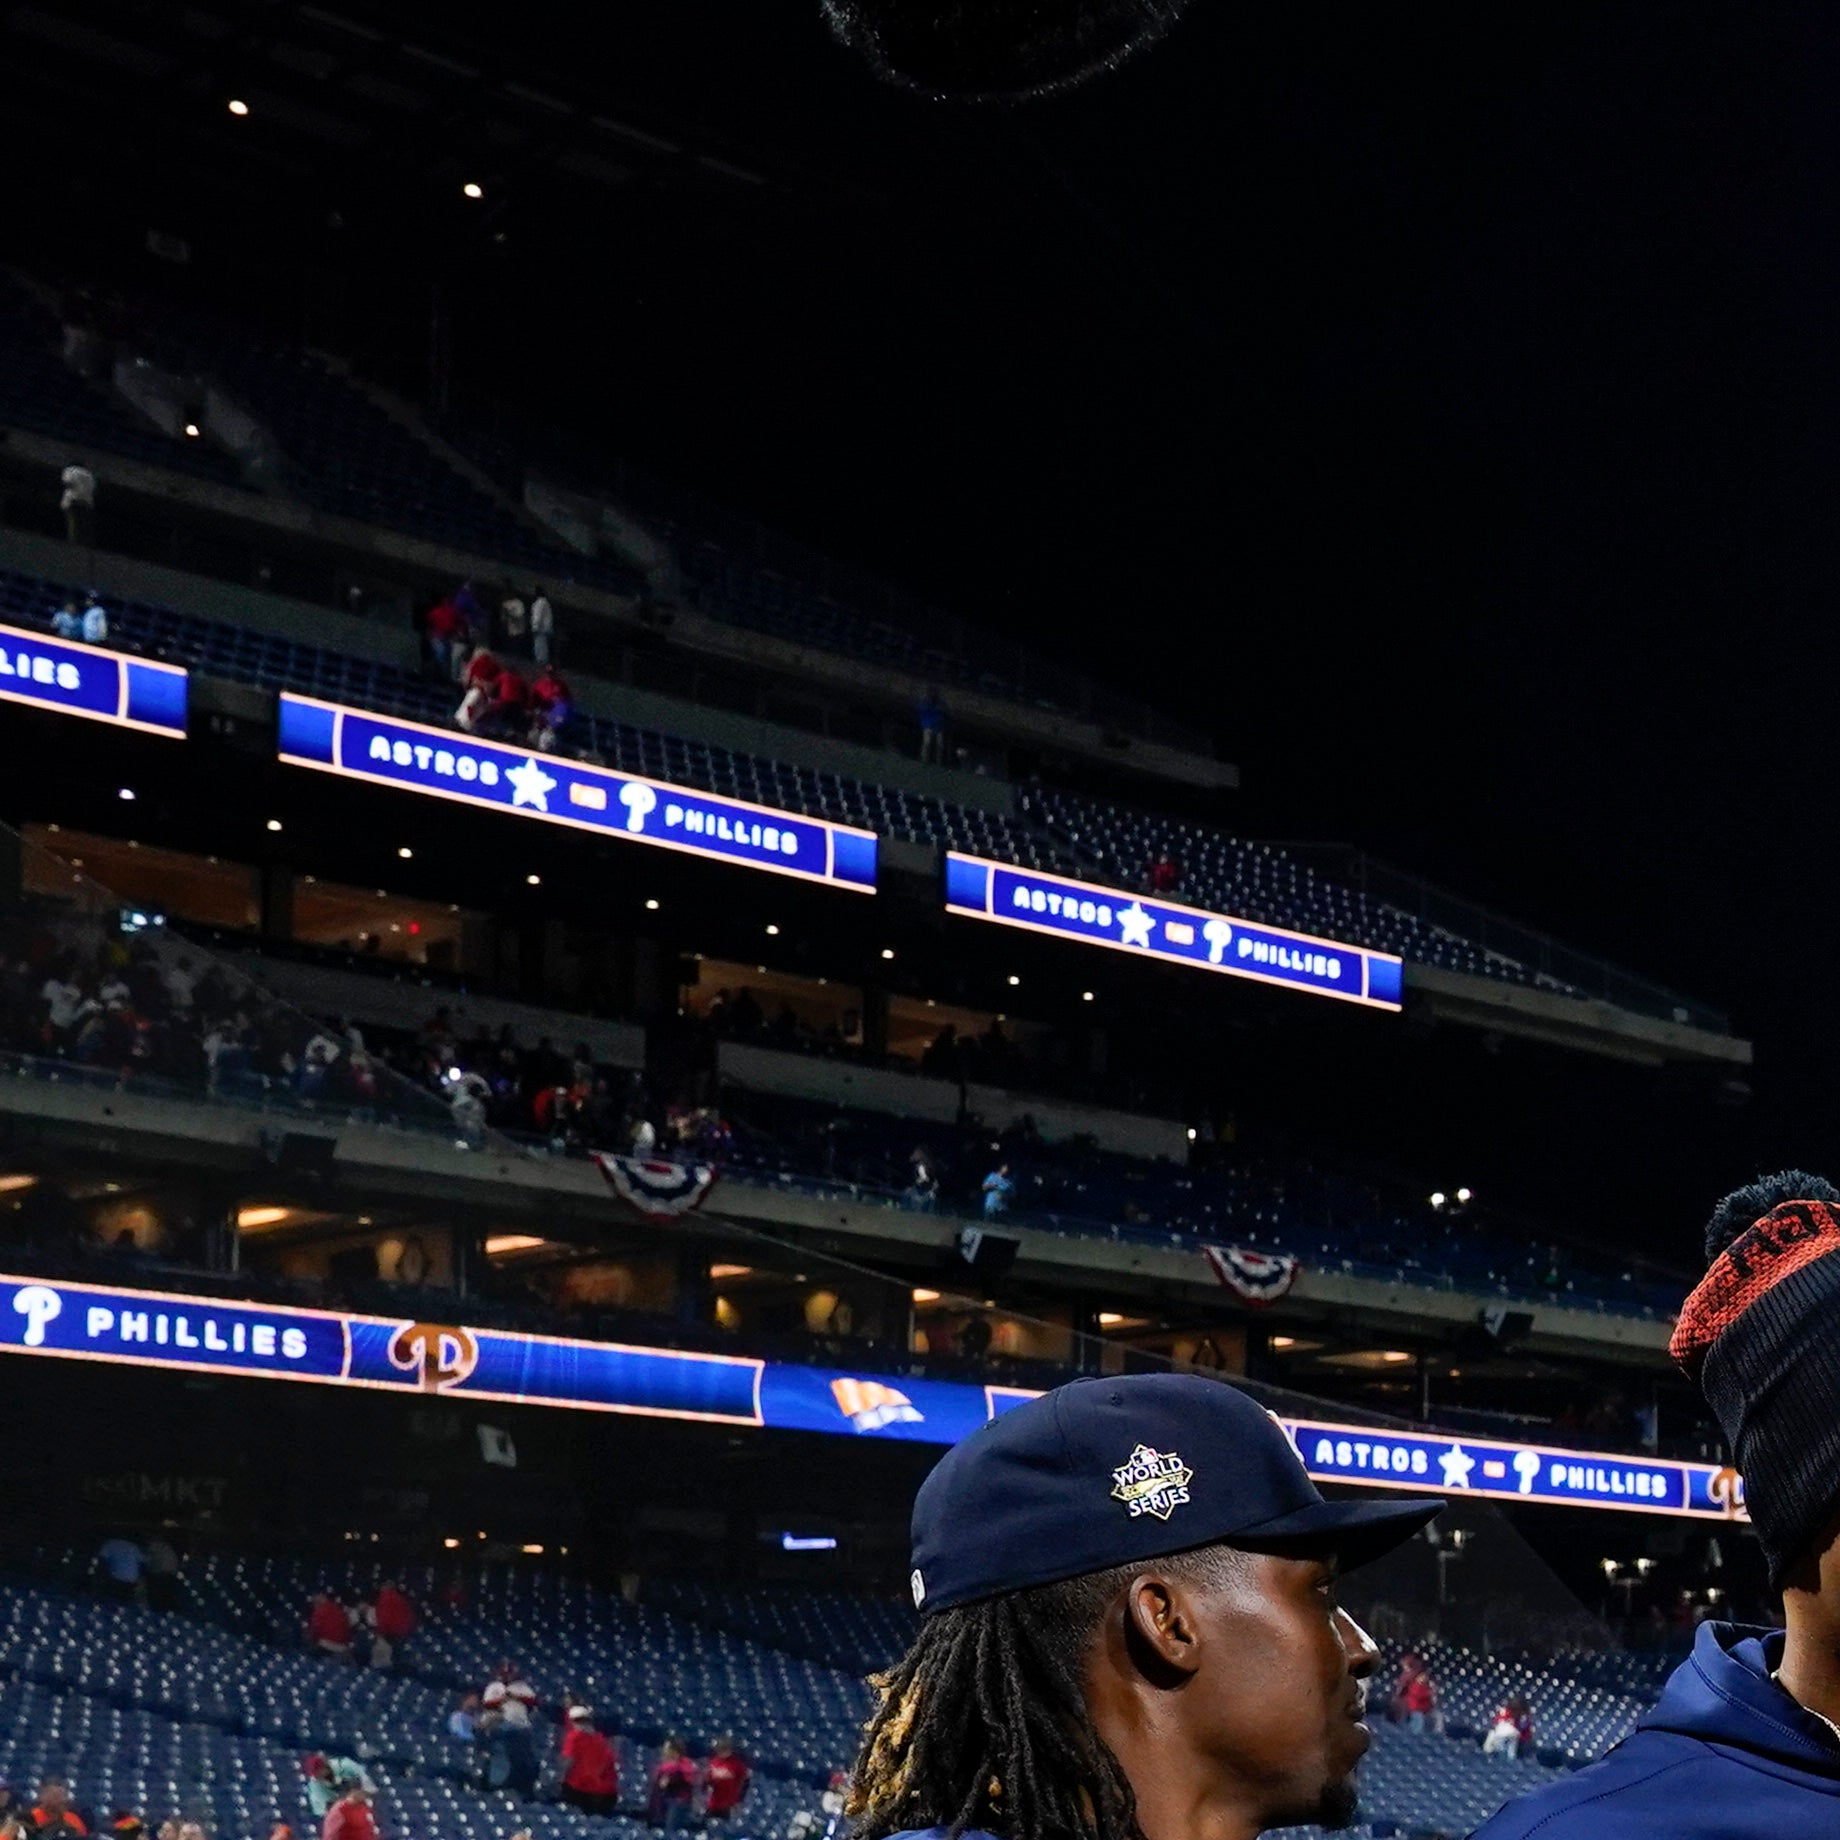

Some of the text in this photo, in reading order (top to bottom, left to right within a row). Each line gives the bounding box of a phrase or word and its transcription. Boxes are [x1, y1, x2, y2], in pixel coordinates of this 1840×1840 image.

[369, 734, 499, 786] ASTROS
[664, 802, 799, 857] PHILLIES
[1012, 885, 1112, 926] ASTROS
[1238, 938, 1341, 980] PHILLIES
[86, 1305, 309, 1359] PHILLIES
[1112, 1457, 1185, 1488] WORLD
[1315, 1438, 1428, 1477] ASTROS
[1551, 1464, 1669, 1499] PHILLIES
[1128, 1487, 1191, 1518] SERIES
